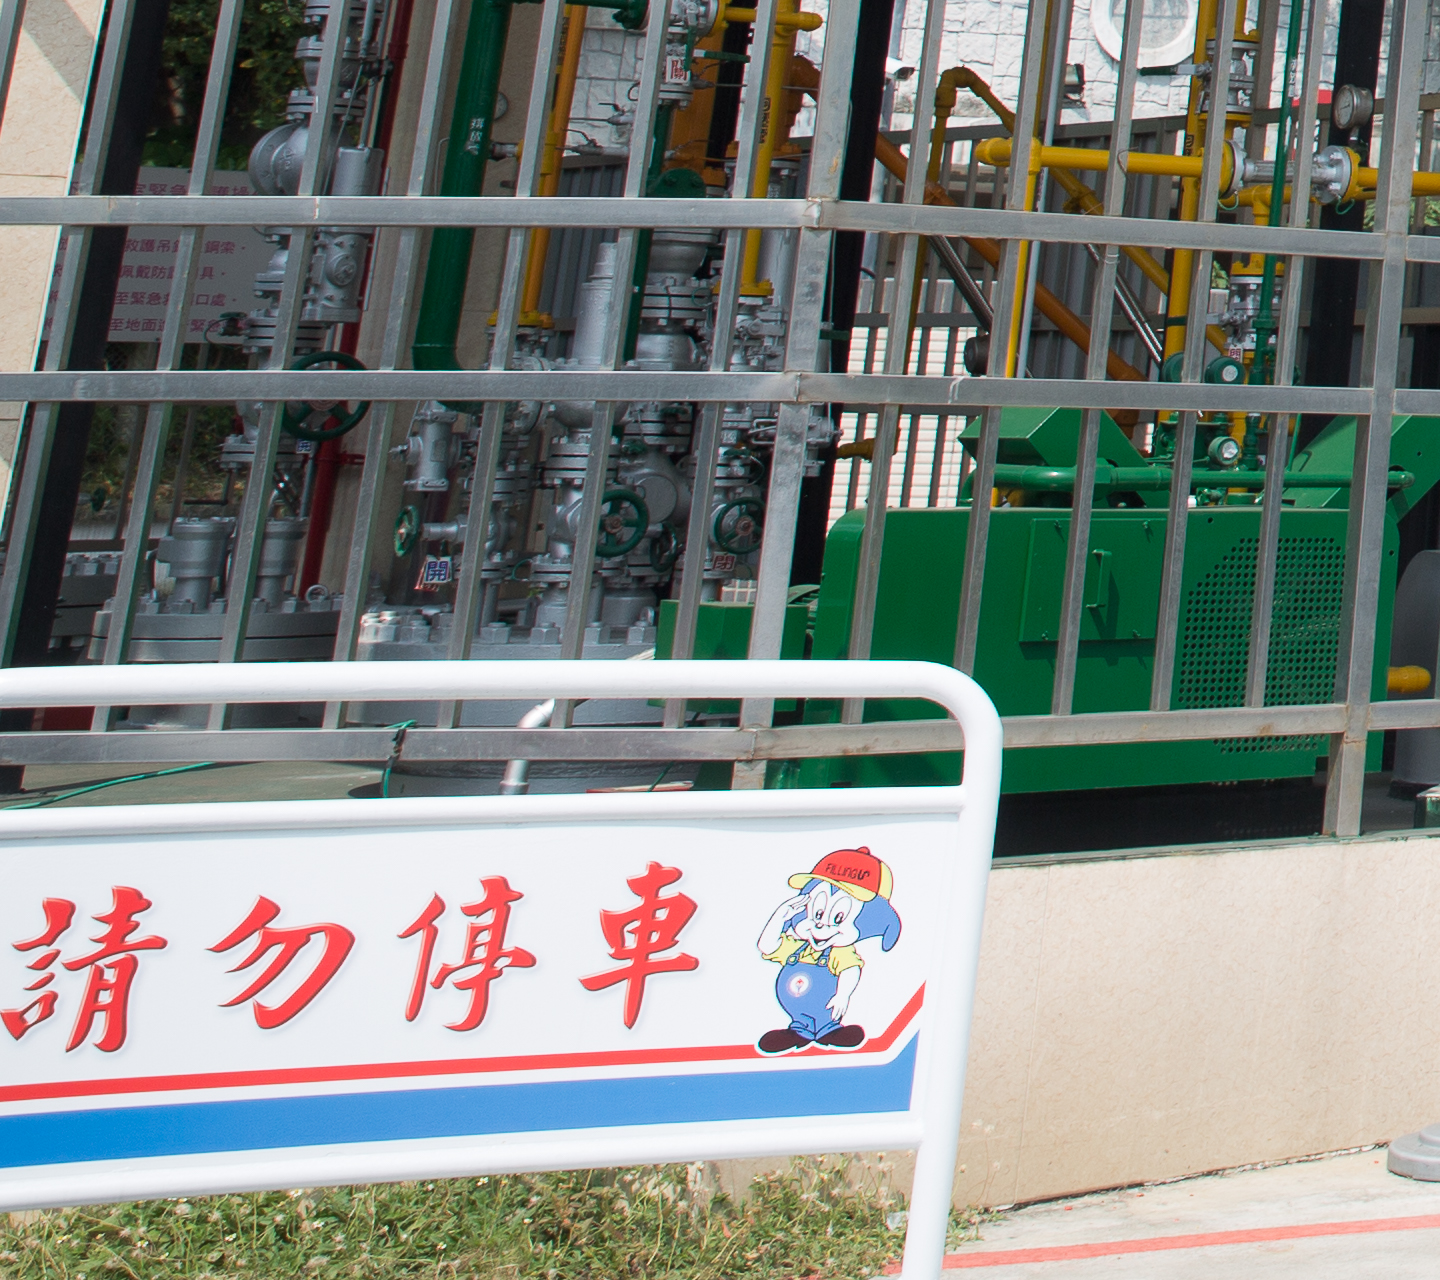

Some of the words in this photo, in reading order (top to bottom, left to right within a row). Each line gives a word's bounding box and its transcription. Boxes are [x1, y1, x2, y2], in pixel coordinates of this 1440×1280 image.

[425, 561, 449, 582] 開
[0, 860, 701, 1055] 請勿停車
